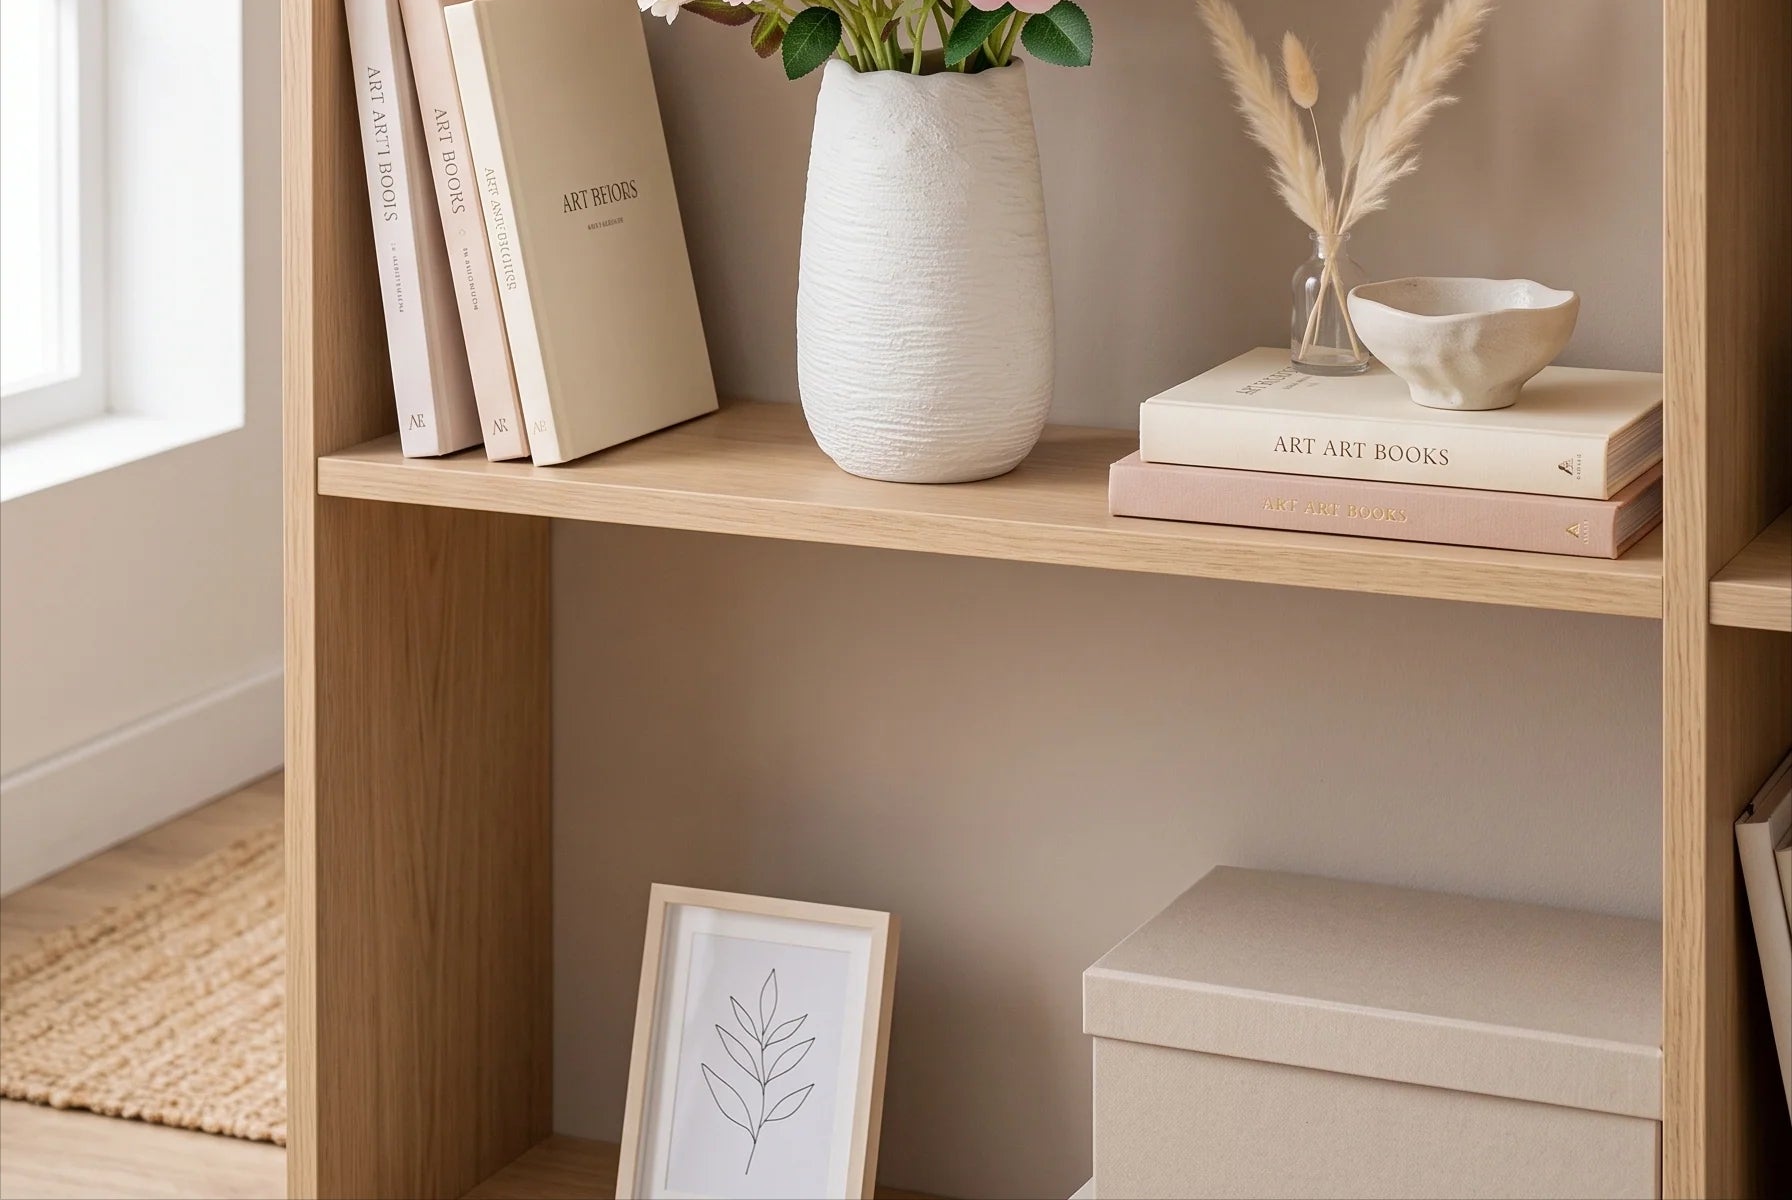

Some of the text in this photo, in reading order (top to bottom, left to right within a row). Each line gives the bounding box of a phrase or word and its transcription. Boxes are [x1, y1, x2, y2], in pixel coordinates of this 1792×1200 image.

[367, 66, 385, 104] ART
[434, 108, 454, 143] ART
[563, 189, 588, 213] ART
[1273, 436, 1449, 466] ART ART BOOKS
[1262, 497, 1408, 523] ART ART BOOKS
